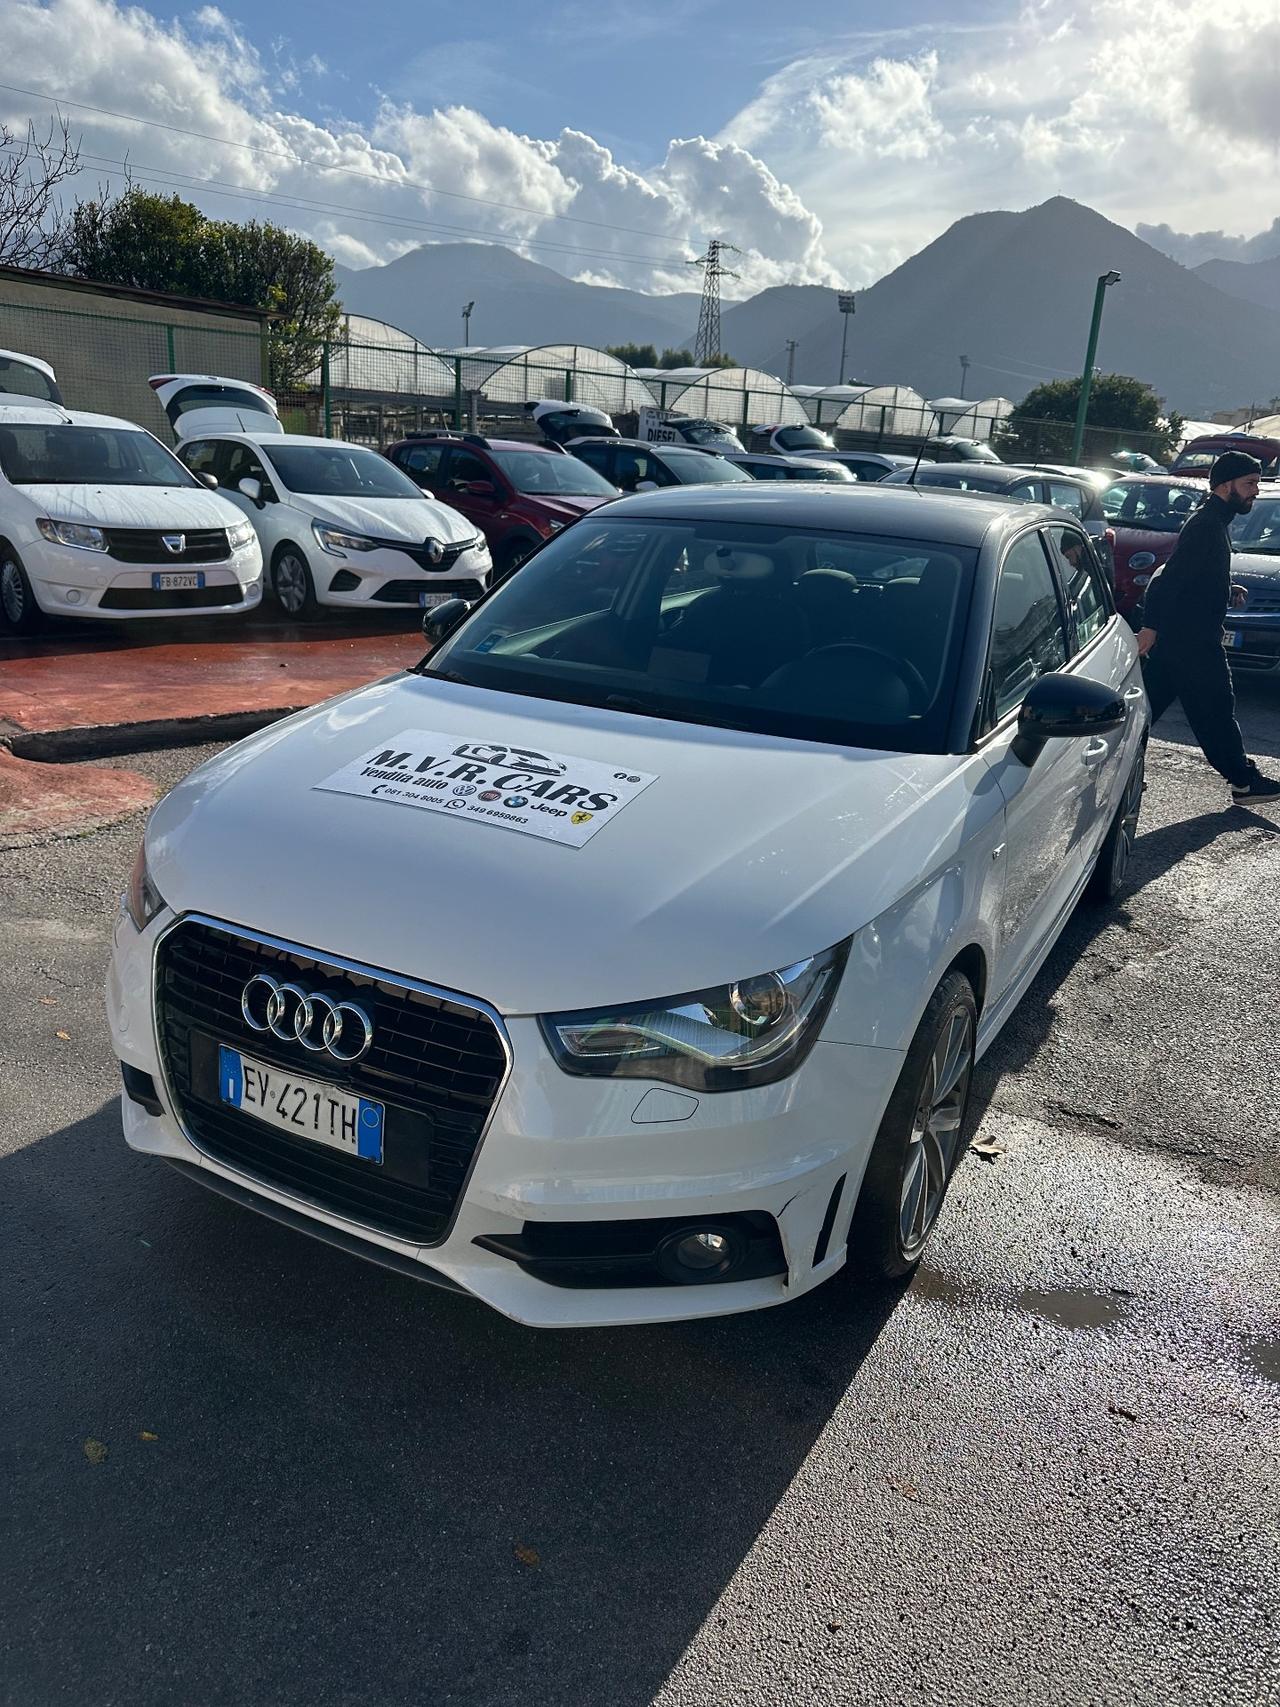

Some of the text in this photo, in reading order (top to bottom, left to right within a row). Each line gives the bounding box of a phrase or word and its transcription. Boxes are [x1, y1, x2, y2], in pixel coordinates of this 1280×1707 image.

[360, 767, 449, 790] Vendita auto
[467, 805, 486, 813] 349
[530, 803, 568, 817] Jeep
[243, 1065, 357, 1144] EY 421TH
